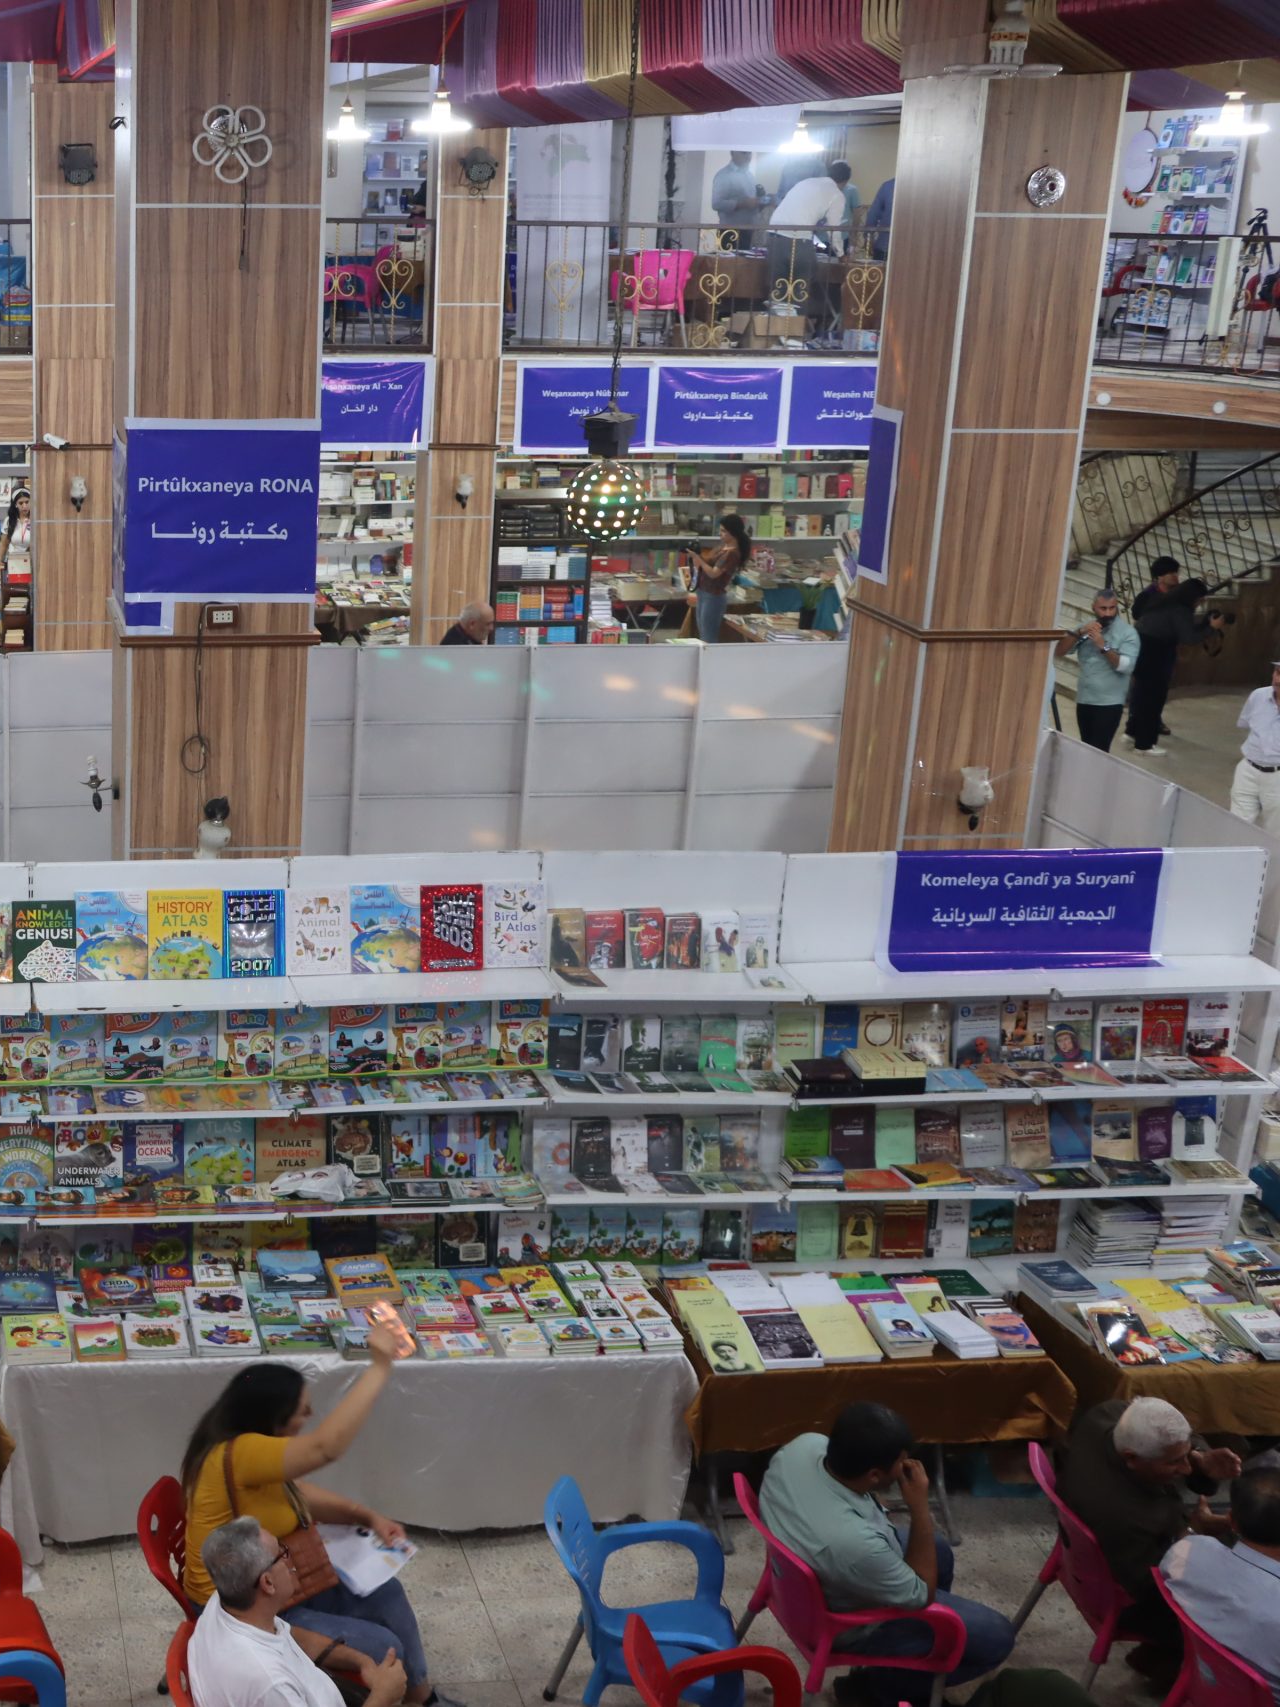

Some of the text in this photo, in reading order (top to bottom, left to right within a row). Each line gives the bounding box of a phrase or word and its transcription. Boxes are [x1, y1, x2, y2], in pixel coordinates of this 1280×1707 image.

[542, 390, 594, 398] Weşanxaneya
[675, 391, 768, 401] Pirtûkxaneya Bindarûk
[368, 404, 378, 414] دار
[722, 410, 753, 422] مكتبة
[138, 477, 314, 496] Pirtûkxaneya RONA
[151, 521, 288, 545] مكتبة رونا
[921, 871, 1136, 890] Komeleya Çandî ya Suryanî
[157, 902, 212, 914] HISTORY
[16, 910, 73, 920] ANIMAL
[494, 911, 518, 922] Bird
[932, 905, 1116, 927] الجمعية الثقافية السريانية
[162, 915, 208, 926] ATLAS
[297, 918, 340, 927] Animal
[506, 922, 537, 932] Atlas
[16, 929, 73, 940] GENIUS!
[311, 928, 341, 938] Atlas
[433, 923, 474, 952] 2008
[231, 960, 272, 972] 2007
[9, 1125, 33, 1136] HOW
[196, 1120, 242, 1134] ATLAS
[138, 1138, 171, 1146] IMPORTANT
[271, 1138, 312, 1148] CLIMATE
[1, 1148, 41, 1163] WORKS
[137, 1147, 172, 1156] OCEANS
[262, 1149, 321, 1158] EMERGENCY
[276, 1158, 307, 1167] ATLAS
[57, 1166, 121, 1176] UNDERWATER
[59, 1176, 101, 1186] ANIMALS
